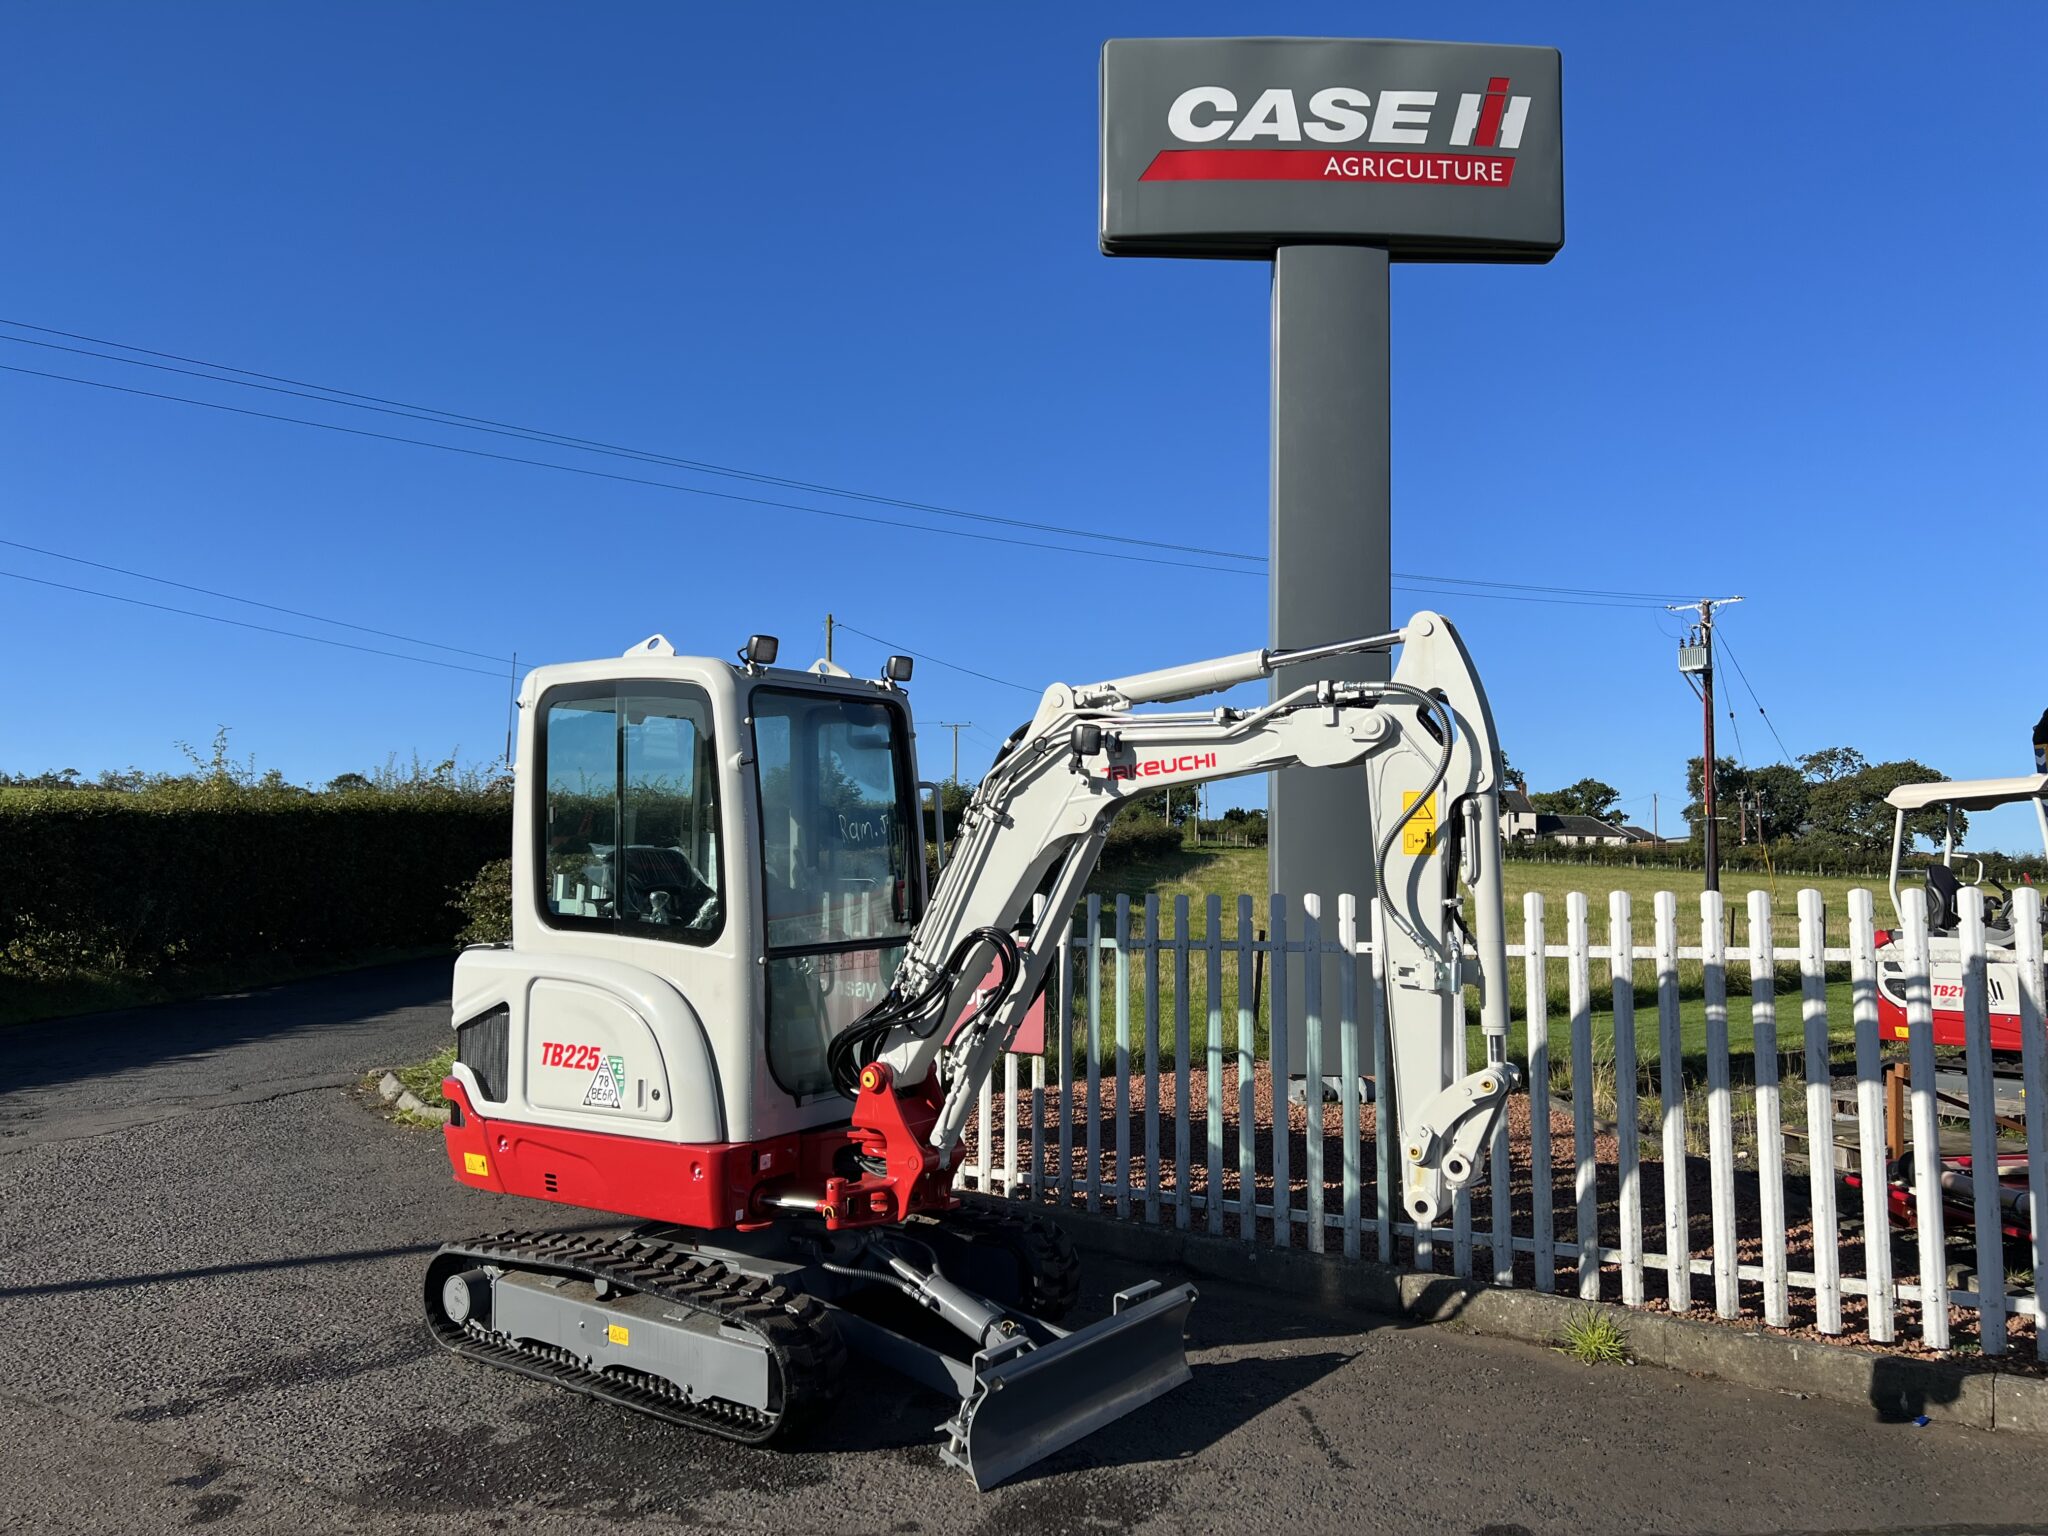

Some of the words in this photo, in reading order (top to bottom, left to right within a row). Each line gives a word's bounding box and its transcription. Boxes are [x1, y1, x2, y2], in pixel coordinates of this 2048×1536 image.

[1167, 86, 1438, 144] CASE
[1324, 157, 1503, 182] AGRICULTURE
[1933, 985, 1965, 997] TB21
[542, 1042, 602, 1071] TB225
[599, 1075, 609, 1087] 78
